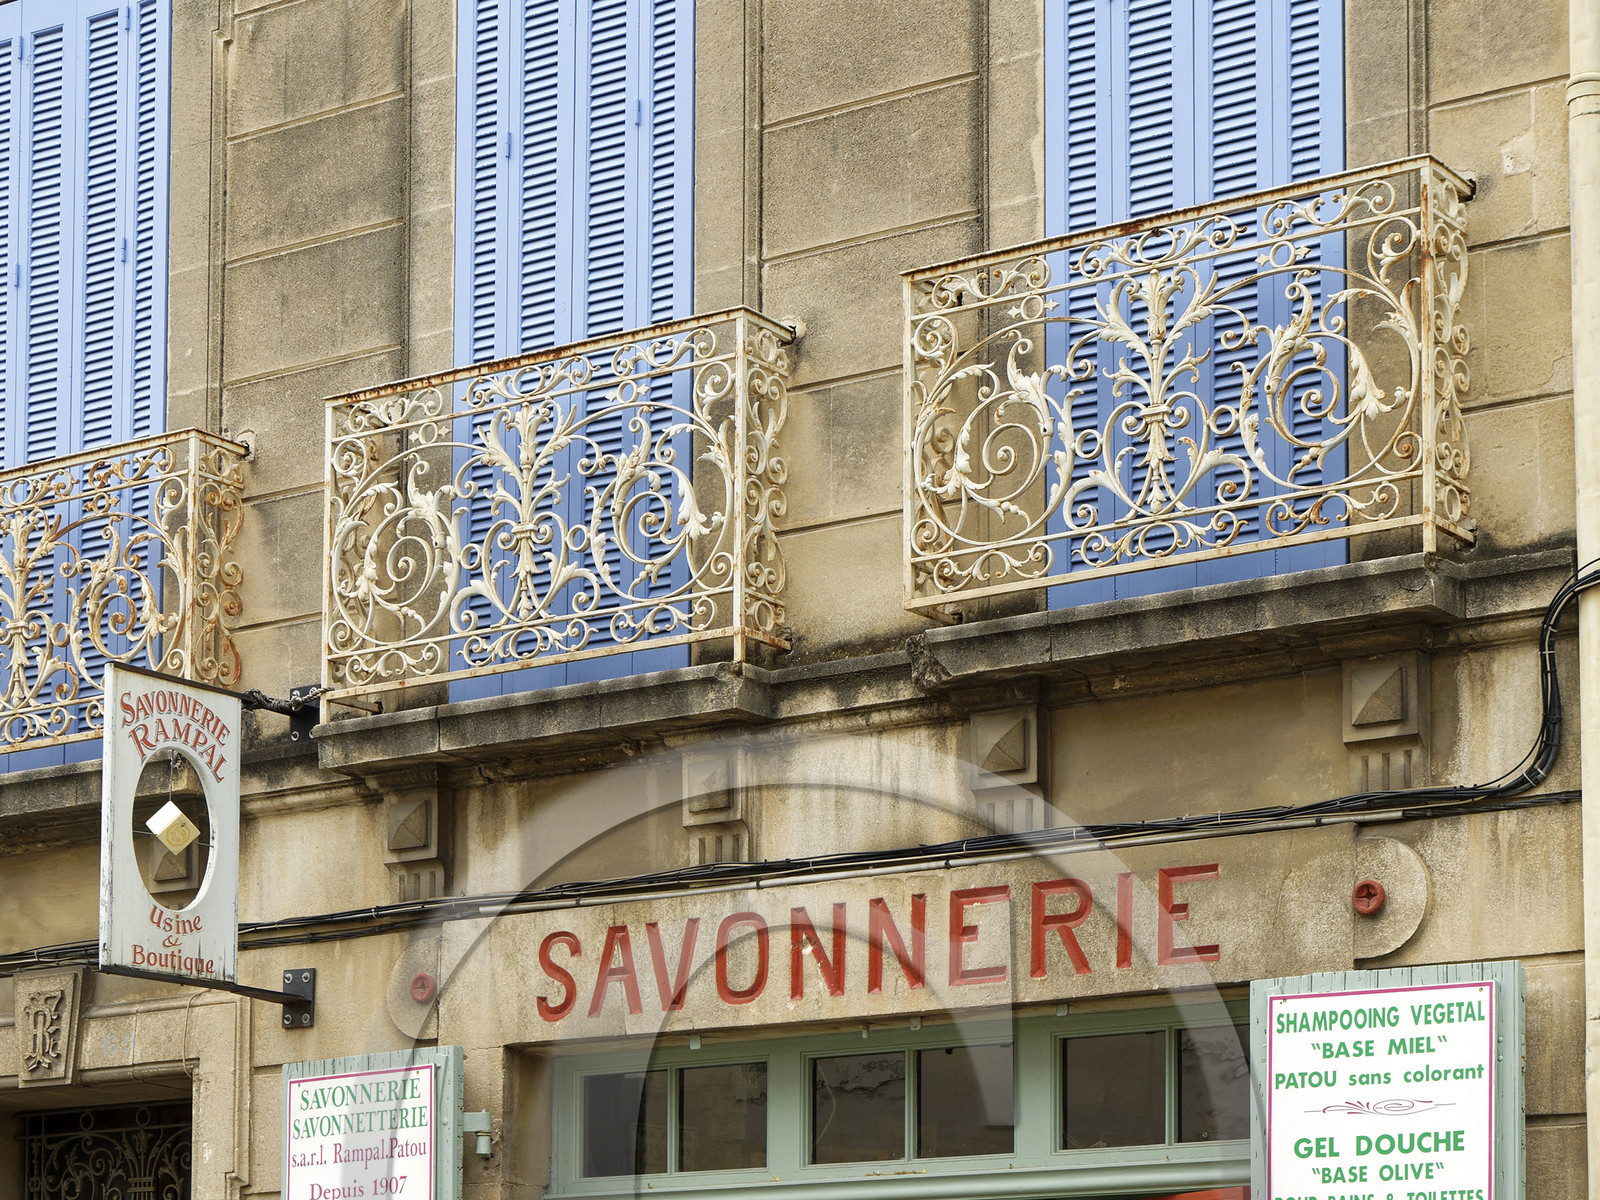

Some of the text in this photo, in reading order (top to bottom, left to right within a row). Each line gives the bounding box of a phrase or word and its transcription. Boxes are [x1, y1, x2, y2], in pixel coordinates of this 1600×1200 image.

[121, 690, 230, 748] SAVONNERIE
[129, 717, 225, 783] RAMPAL
[150, 904, 202, 935] Usine
[163, 934, 182, 948] &
[537, 863, 1220, 1022] SAVONNERIE
[132, 944, 215, 976] Boutique
[1276, 1001, 1485, 1034] SHAMPOOING VEGETAL
[1276, 1064, 1484, 1090] PATOU sans colorant
[300, 1078, 421, 1110] SAVONNERIE
[293, 1106, 428, 1140] SAVONNETTERIE
[292, 1144, 326, 1167] s.a.r.l.
[1294, 1130, 1465, 1159] GEL DOUCHE
[373, 1176, 407, 1196] 1907
